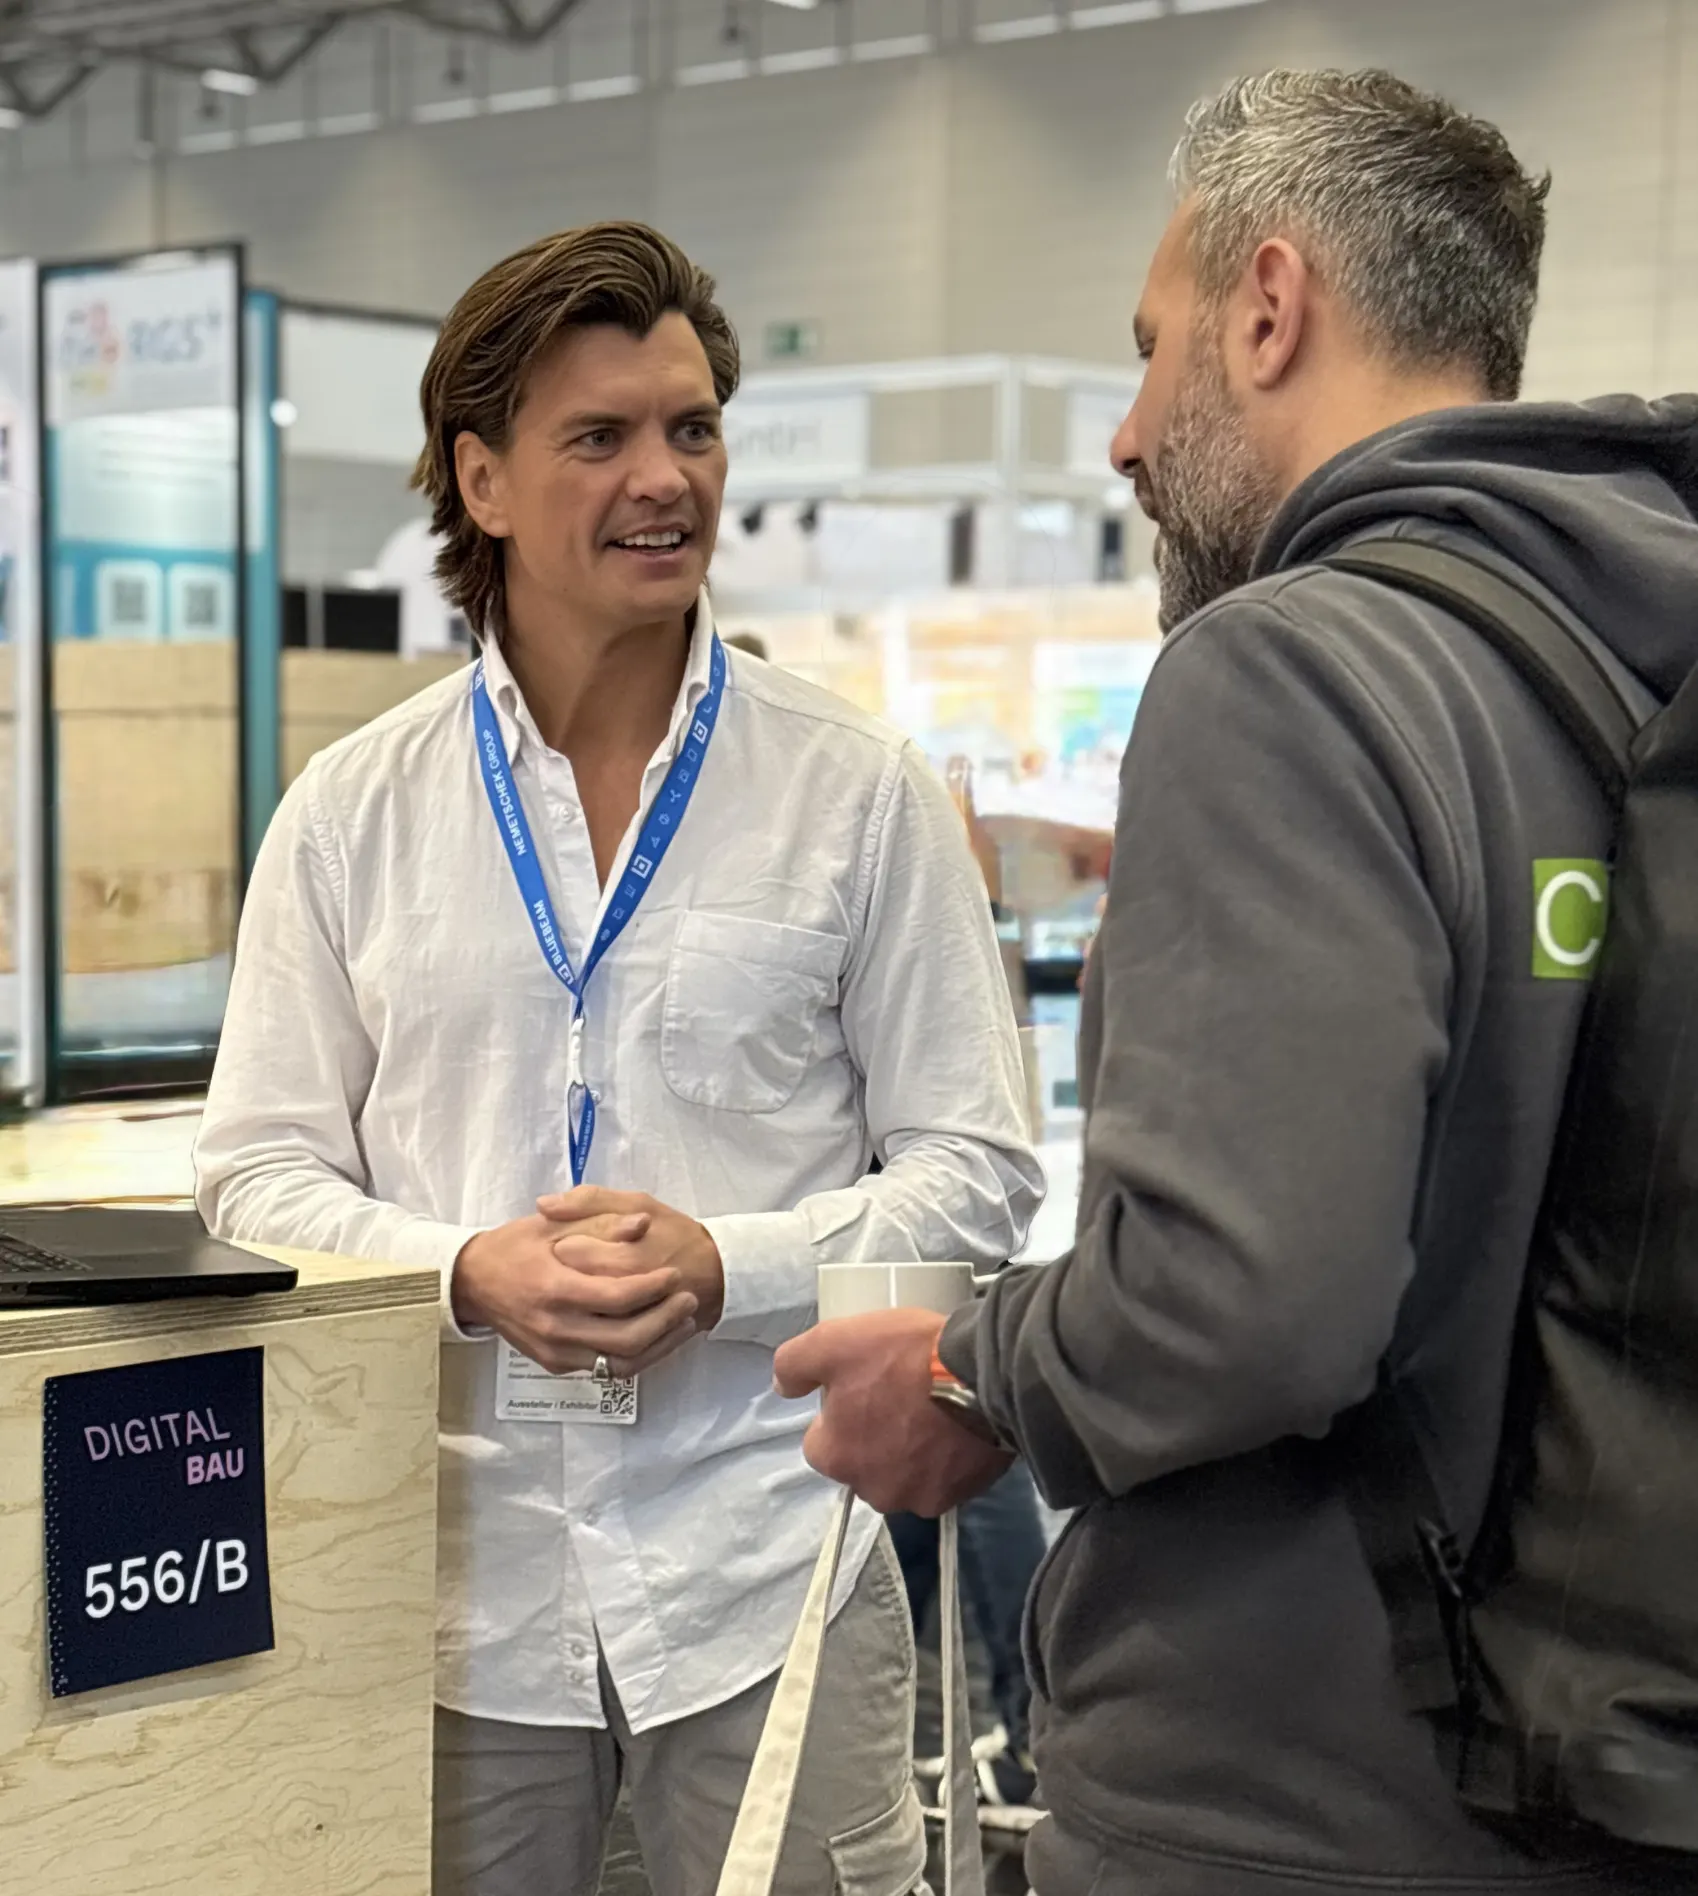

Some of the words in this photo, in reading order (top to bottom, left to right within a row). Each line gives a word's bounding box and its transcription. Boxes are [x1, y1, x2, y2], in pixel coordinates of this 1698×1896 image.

[483, 729, 500, 769] GROUP
[492, 770, 528, 856] NEMETSCHEK
[533, 900, 563, 966] BLUEBEAM
[1536, 870, 1602, 966] C
[84, 1407, 231, 1461] DIGITAL
[507, 1400, 553, 1410] Aussteller
[560, 1401, 598, 1411] Exhibitor
[186, 1447, 244, 1486] BAU
[85, 1538, 249, 1619] 556/B
